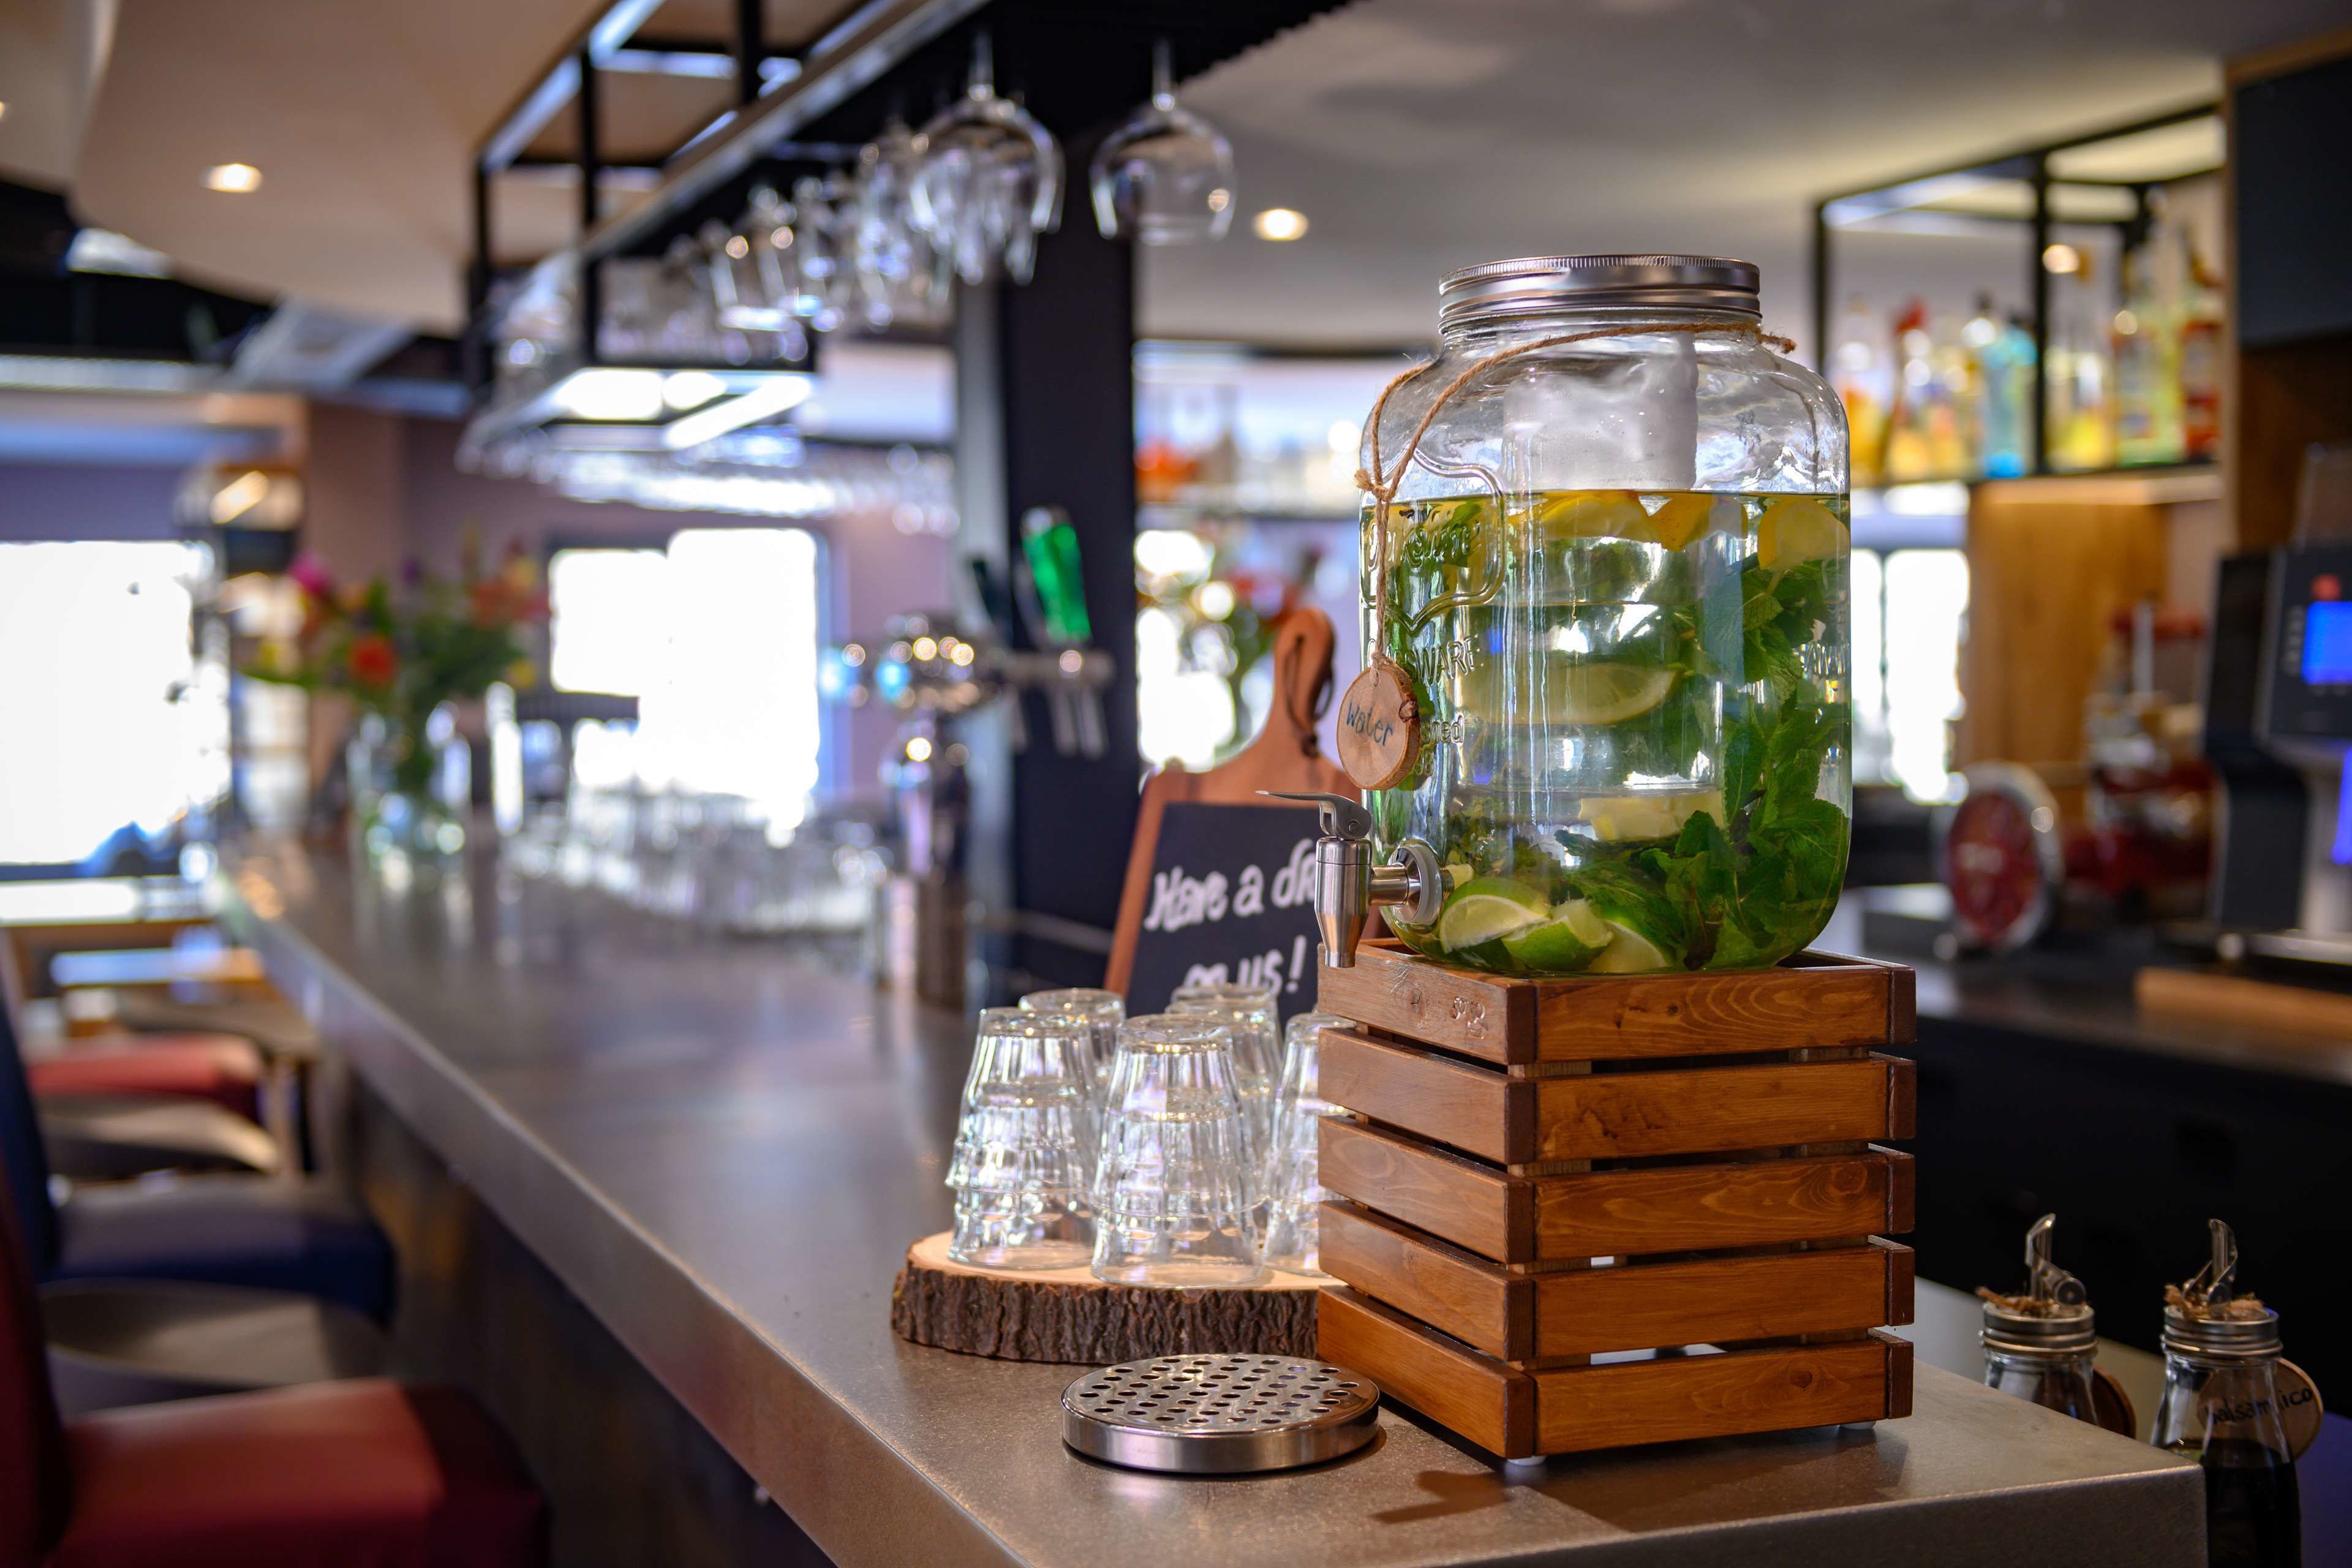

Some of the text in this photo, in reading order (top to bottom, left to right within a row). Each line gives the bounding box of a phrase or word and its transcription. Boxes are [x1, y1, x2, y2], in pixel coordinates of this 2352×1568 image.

[1144, 866, 1229, 932] Have
[1233, 864, 1265, 916] a
[1237, 935, 1307, 996] us!
